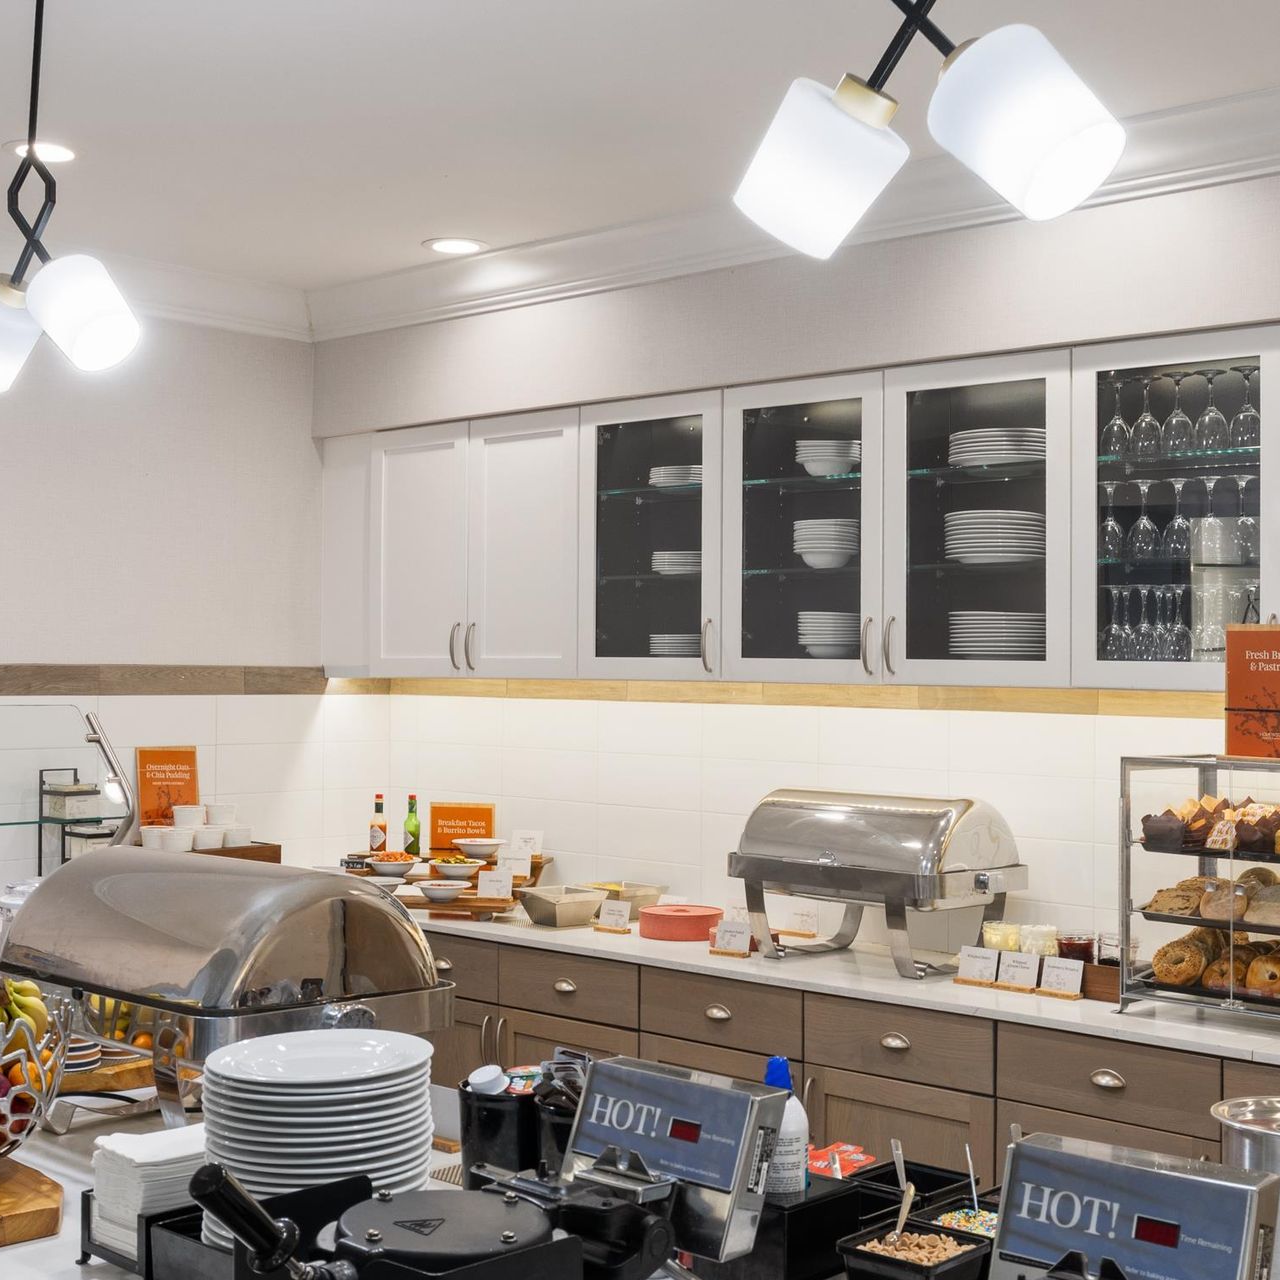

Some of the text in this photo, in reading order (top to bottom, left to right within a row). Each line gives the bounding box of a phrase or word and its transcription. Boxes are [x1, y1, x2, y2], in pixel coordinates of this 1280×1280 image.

[1246, 650, 1270, 660] Fresh
[1250, 662, 1257, 671] &
[166, 772, 191, 780] Pudding
[438, 819, 467, 827] Breakfast
[588, 1093, 662, 1138] HOT!
[1017, 1182, 1120, 1239] HOT!
[1180, 1234, 1233, 1254] Time Remaining
[1125, 1266, 1139, 1274] Refer
